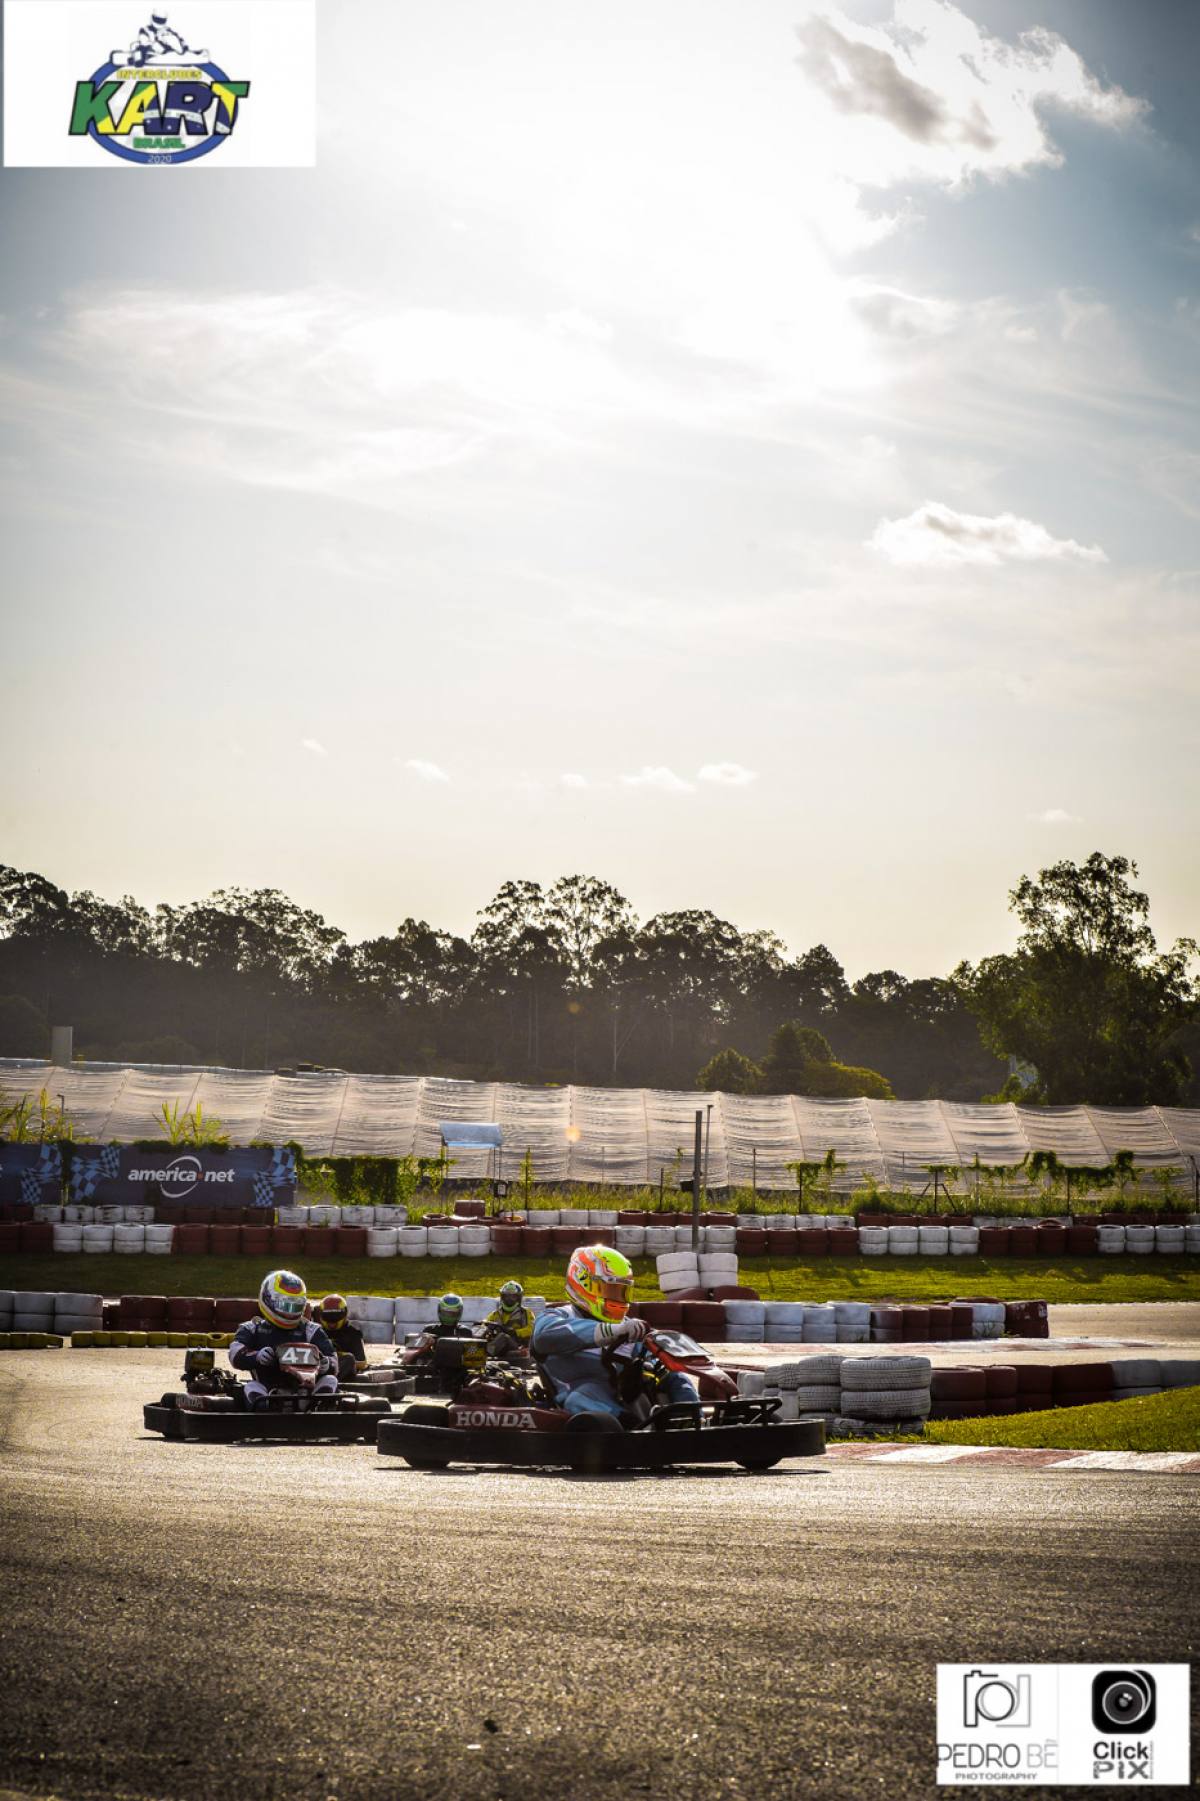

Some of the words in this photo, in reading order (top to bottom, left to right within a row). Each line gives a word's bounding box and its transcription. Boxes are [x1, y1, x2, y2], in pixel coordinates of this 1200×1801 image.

[655, 1334, 701, 1356] 31
[282, 1347, 312, 1364] 47
[456, 1411, 537, 1429] HONDA
